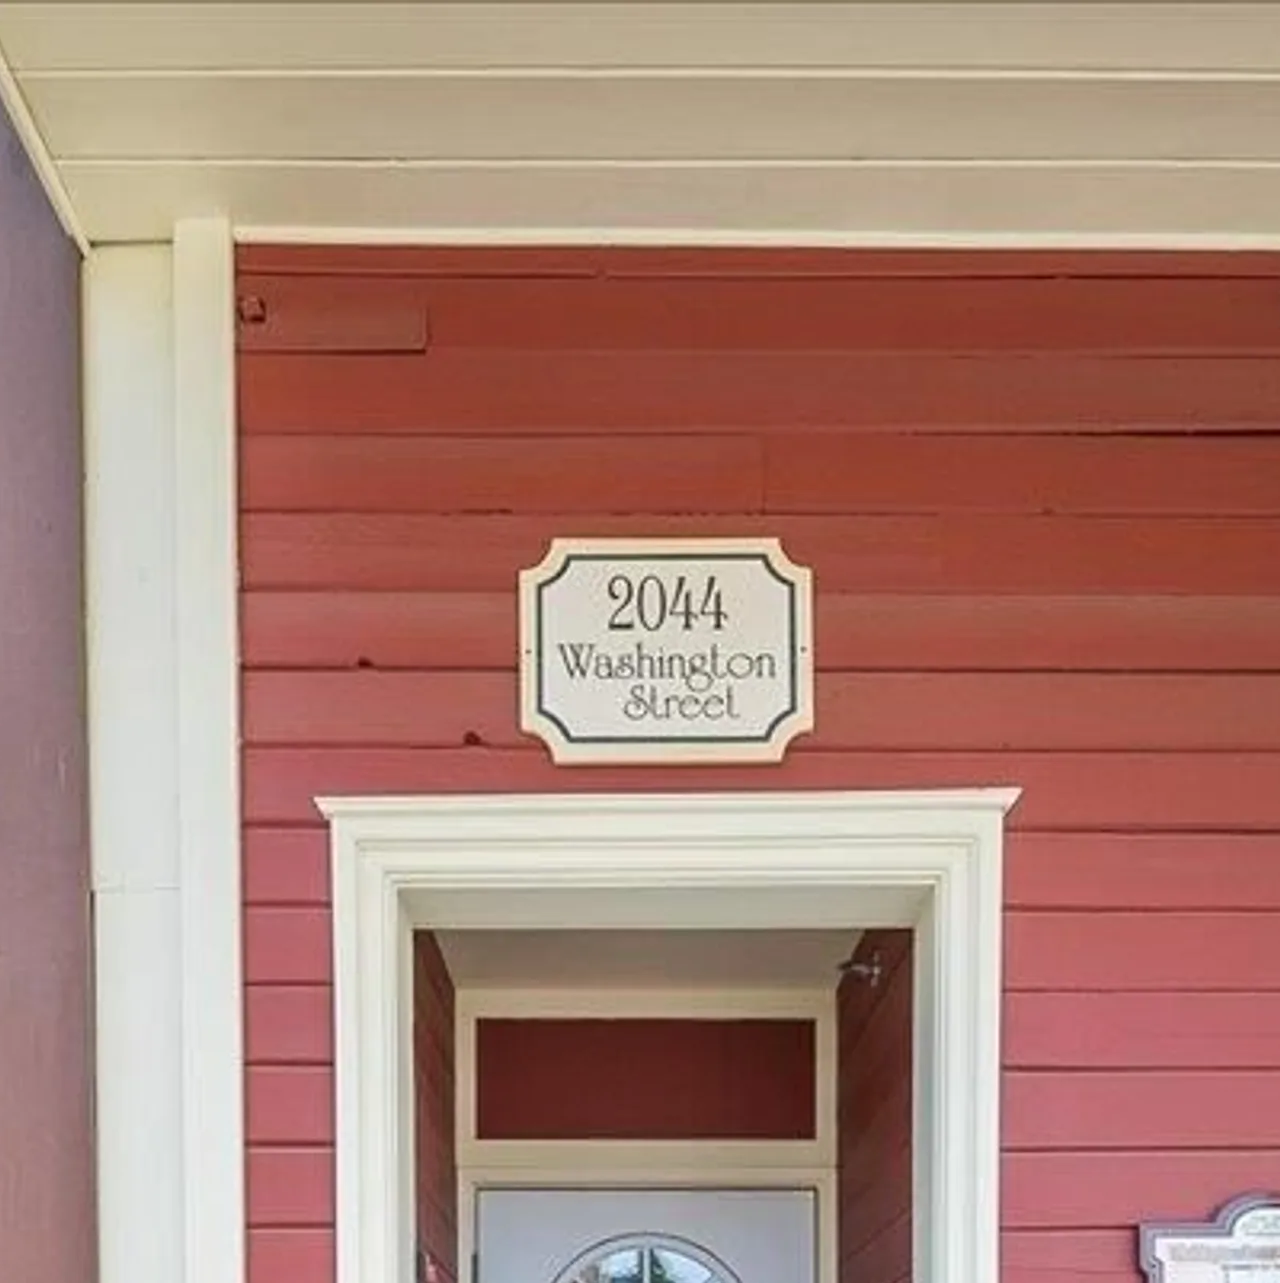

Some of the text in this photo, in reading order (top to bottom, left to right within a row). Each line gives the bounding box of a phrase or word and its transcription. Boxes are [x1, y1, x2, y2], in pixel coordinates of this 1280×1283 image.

[607, 575, 728, 632] 2044
[558, 642, 776, 693] Washington
[623, 684, 741, 721] Street
